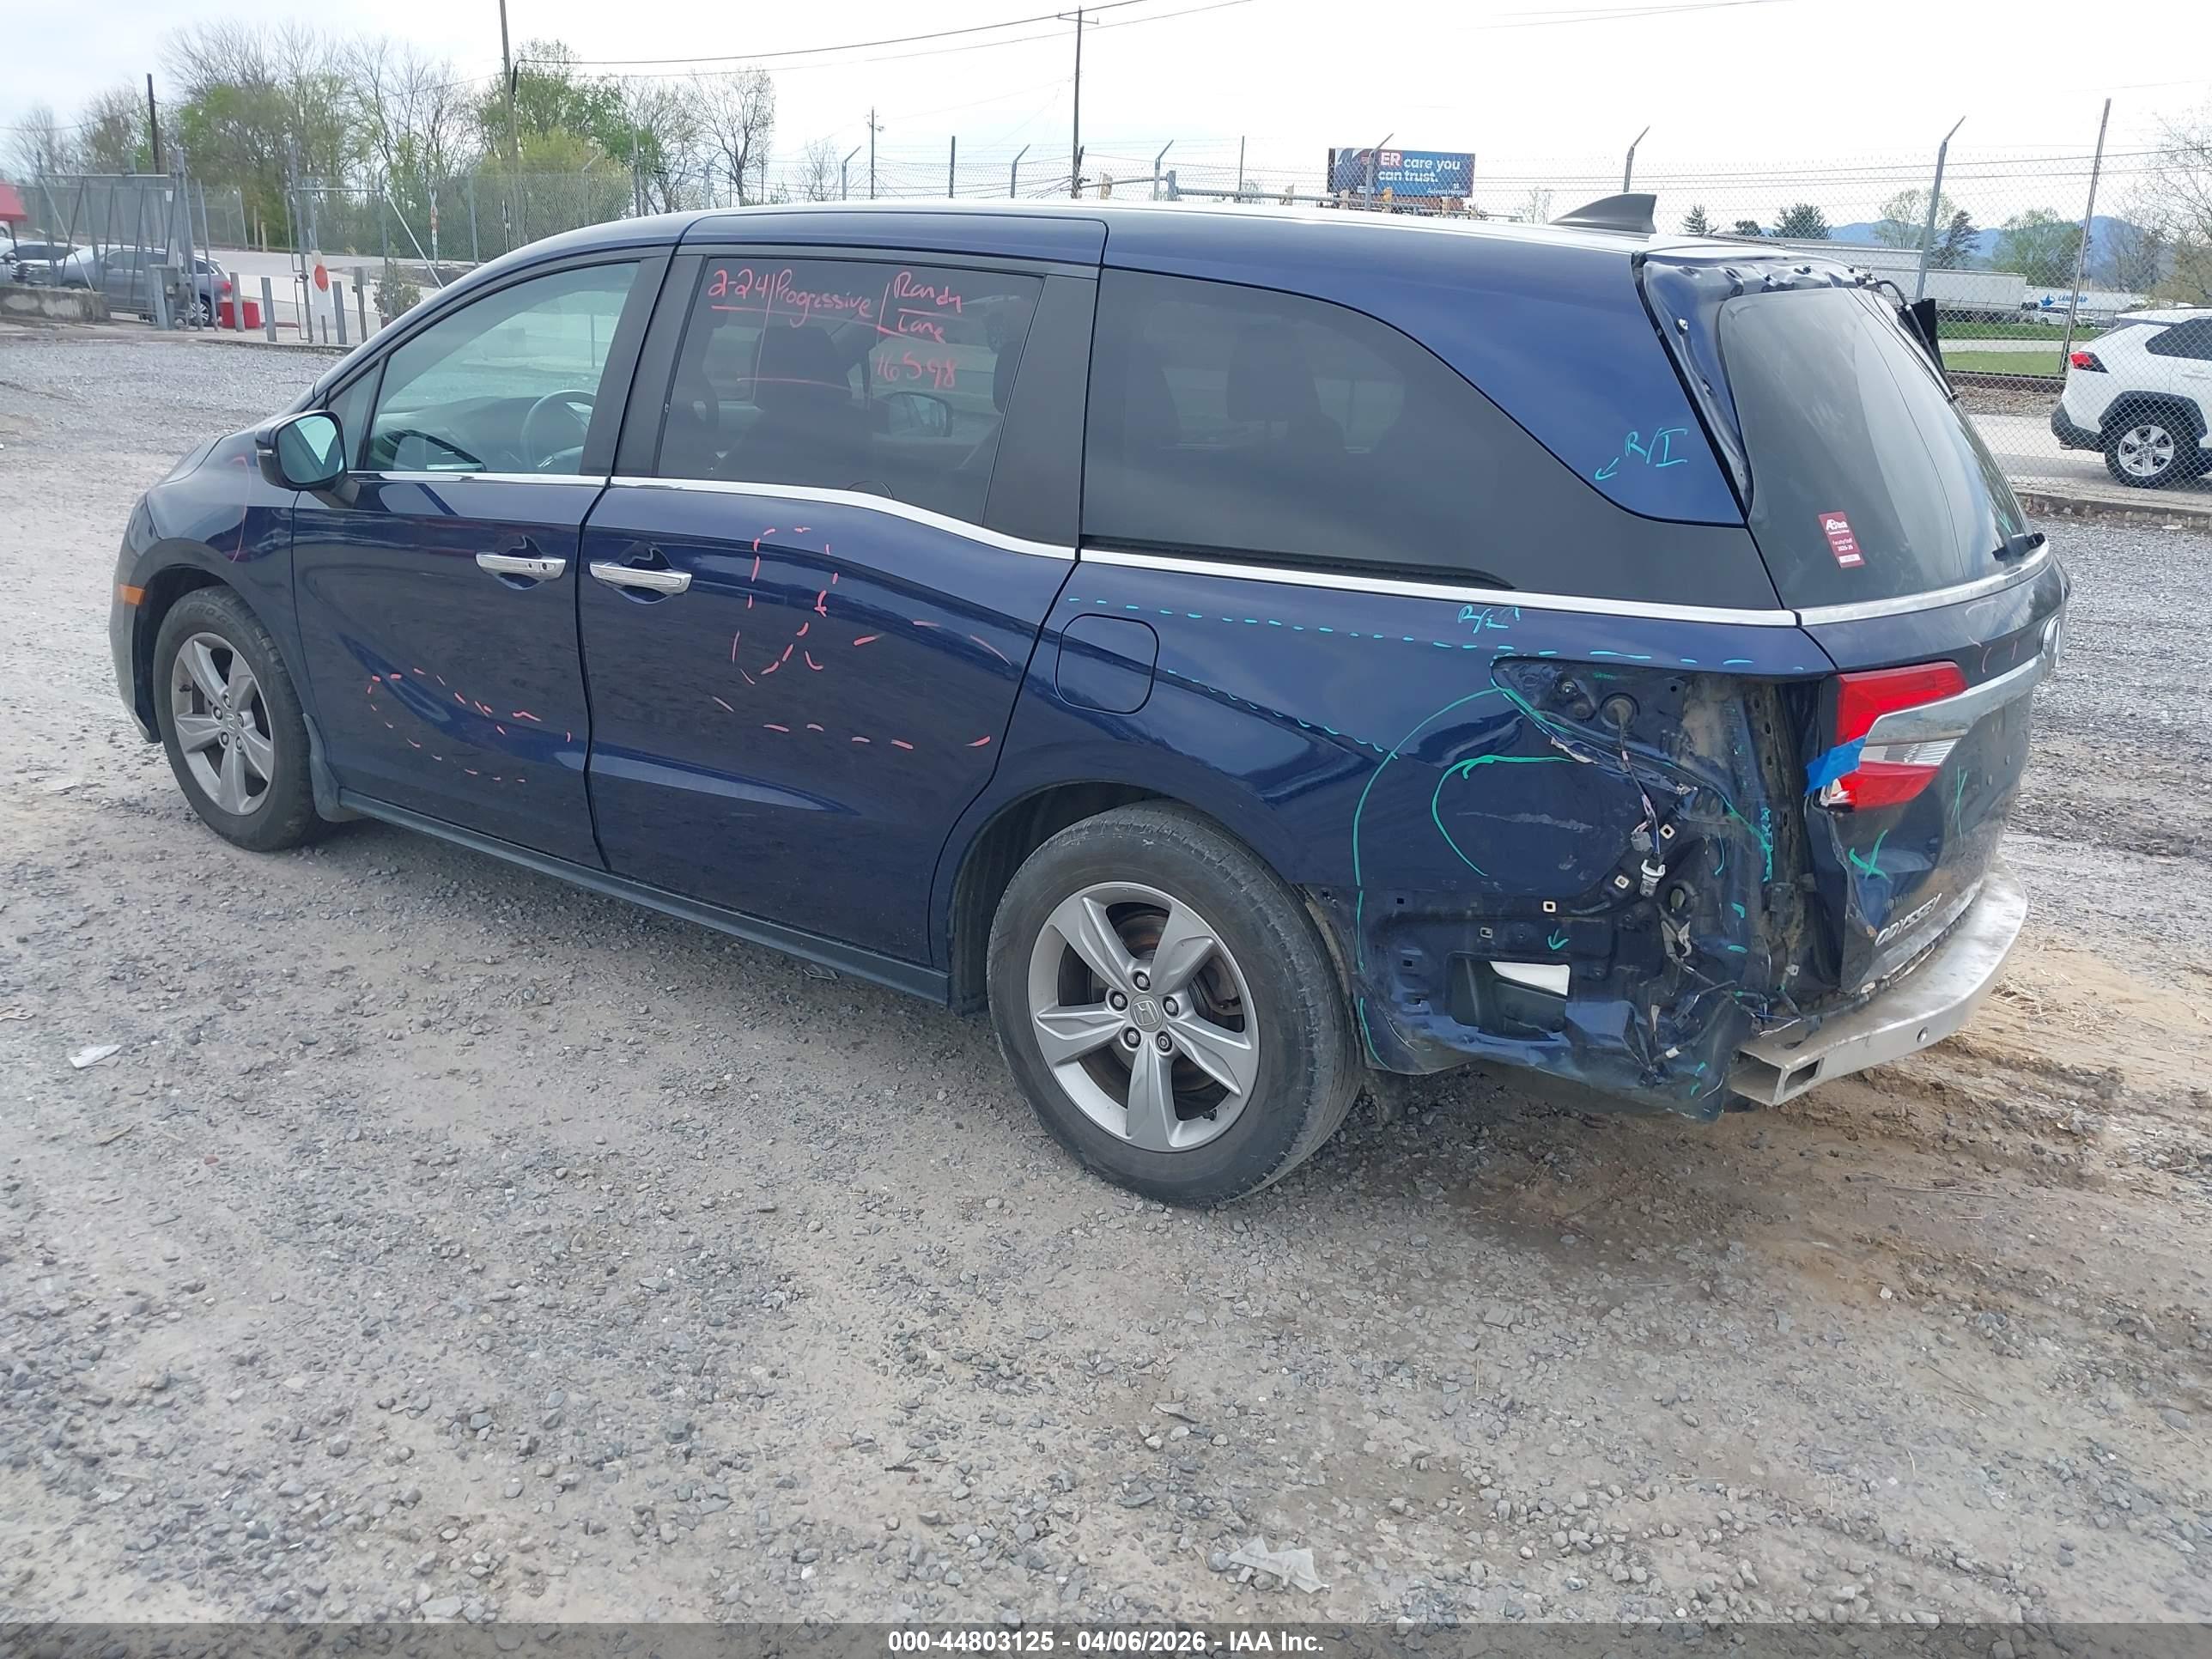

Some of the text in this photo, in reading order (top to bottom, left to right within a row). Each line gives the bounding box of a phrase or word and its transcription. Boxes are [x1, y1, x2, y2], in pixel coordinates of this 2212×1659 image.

[1381, 152, 1401, 167] ER
[1403, 158, 1433, 169] care
[1436, 160, 1461, 173] you
[1378, 170, 1439, 183] can trust.
[775, 268, 873, 329] Progressive
[893, 270, 963, 314] Randy
